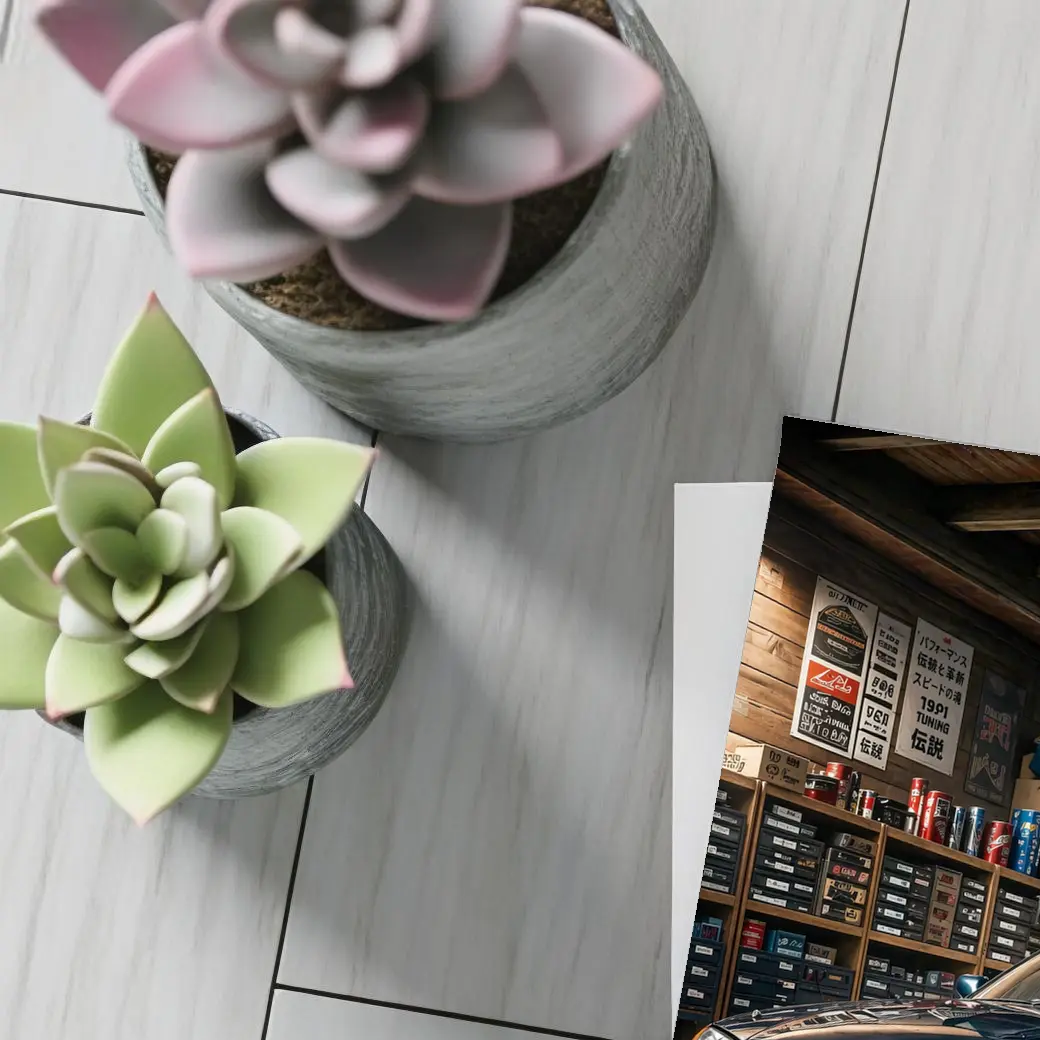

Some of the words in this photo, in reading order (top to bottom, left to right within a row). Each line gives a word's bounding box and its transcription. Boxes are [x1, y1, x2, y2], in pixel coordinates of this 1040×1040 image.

[920, 636, 967, 669] パフォーマンス
[920, 696, 949, 719] 1991
[917, 711, 950, 735] TUNING
[911, 728, 944, 761] 伝説
